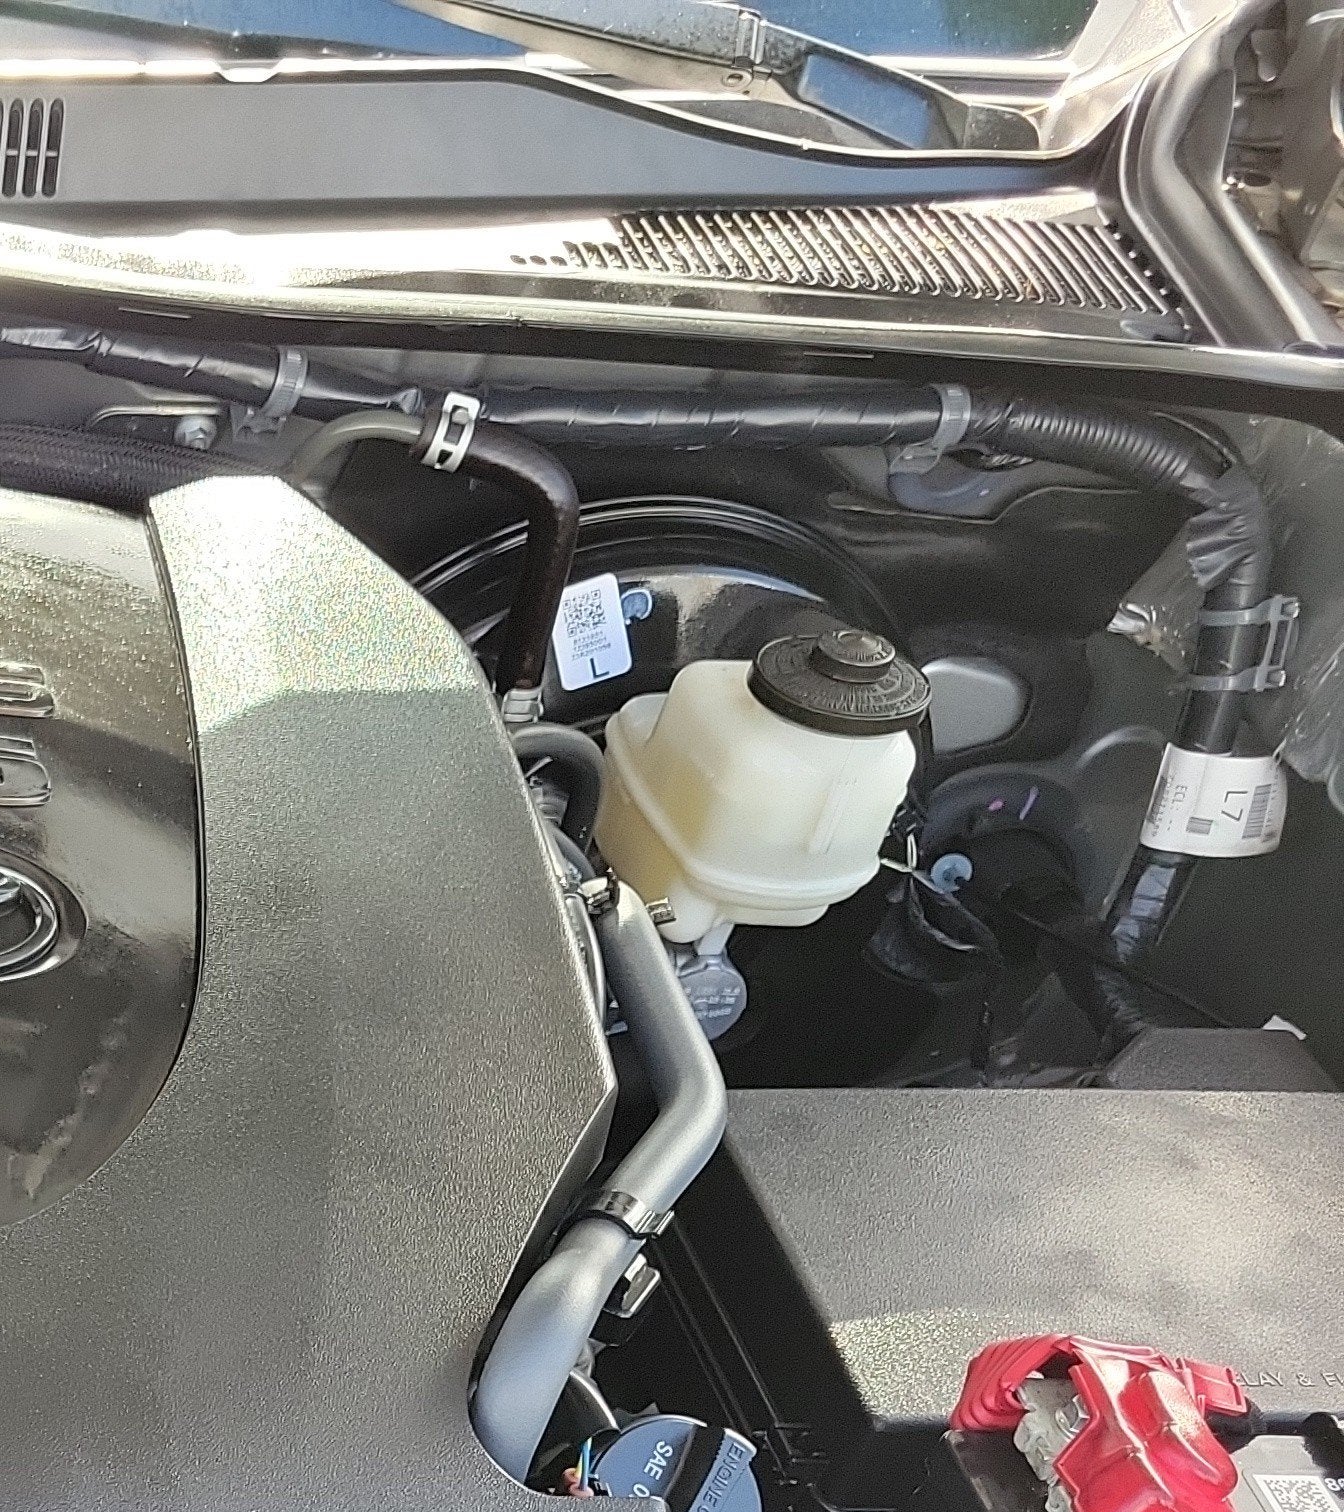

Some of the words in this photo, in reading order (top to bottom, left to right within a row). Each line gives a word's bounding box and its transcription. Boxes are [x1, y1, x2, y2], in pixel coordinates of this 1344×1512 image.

[589, 657, 610, 679] L
[643, 1440, 674, 1481] SAE
[702, 1442, 745, 1508] ENGINE
